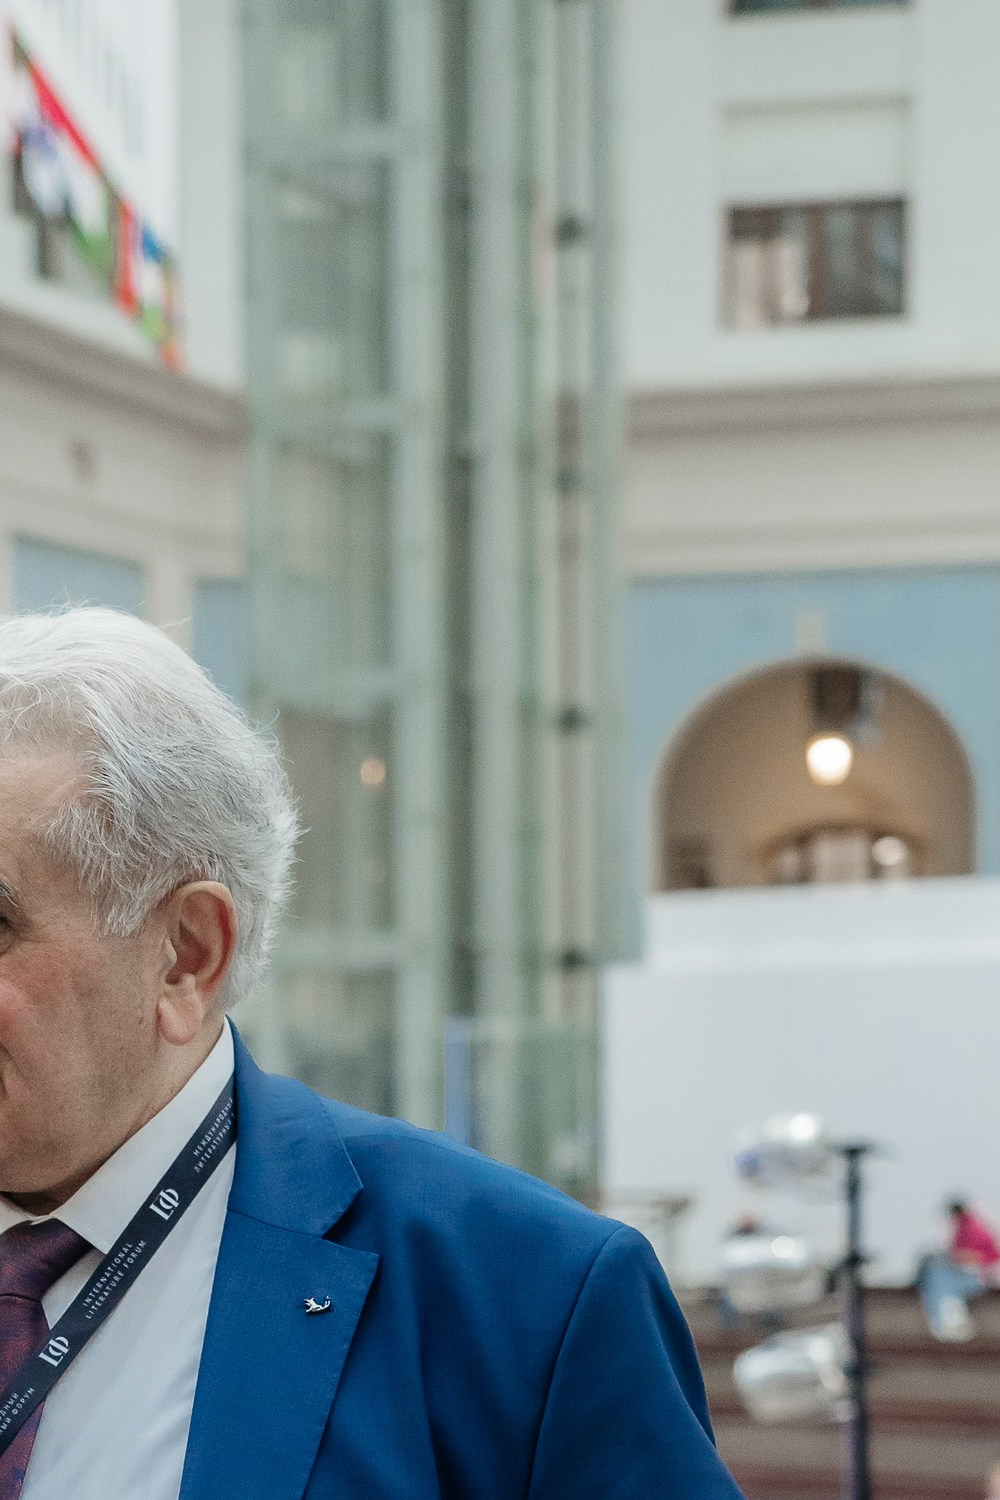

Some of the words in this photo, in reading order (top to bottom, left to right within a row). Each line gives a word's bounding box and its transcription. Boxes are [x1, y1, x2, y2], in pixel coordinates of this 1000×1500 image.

[82, 1242, 133, 1307] INTERNATIONAL
[85, 1270, 125, 1319] LITERATURE
[122, 1240, 147, 1269] FORUM
[11, 1387, 36, 1415] ФОРУМ
